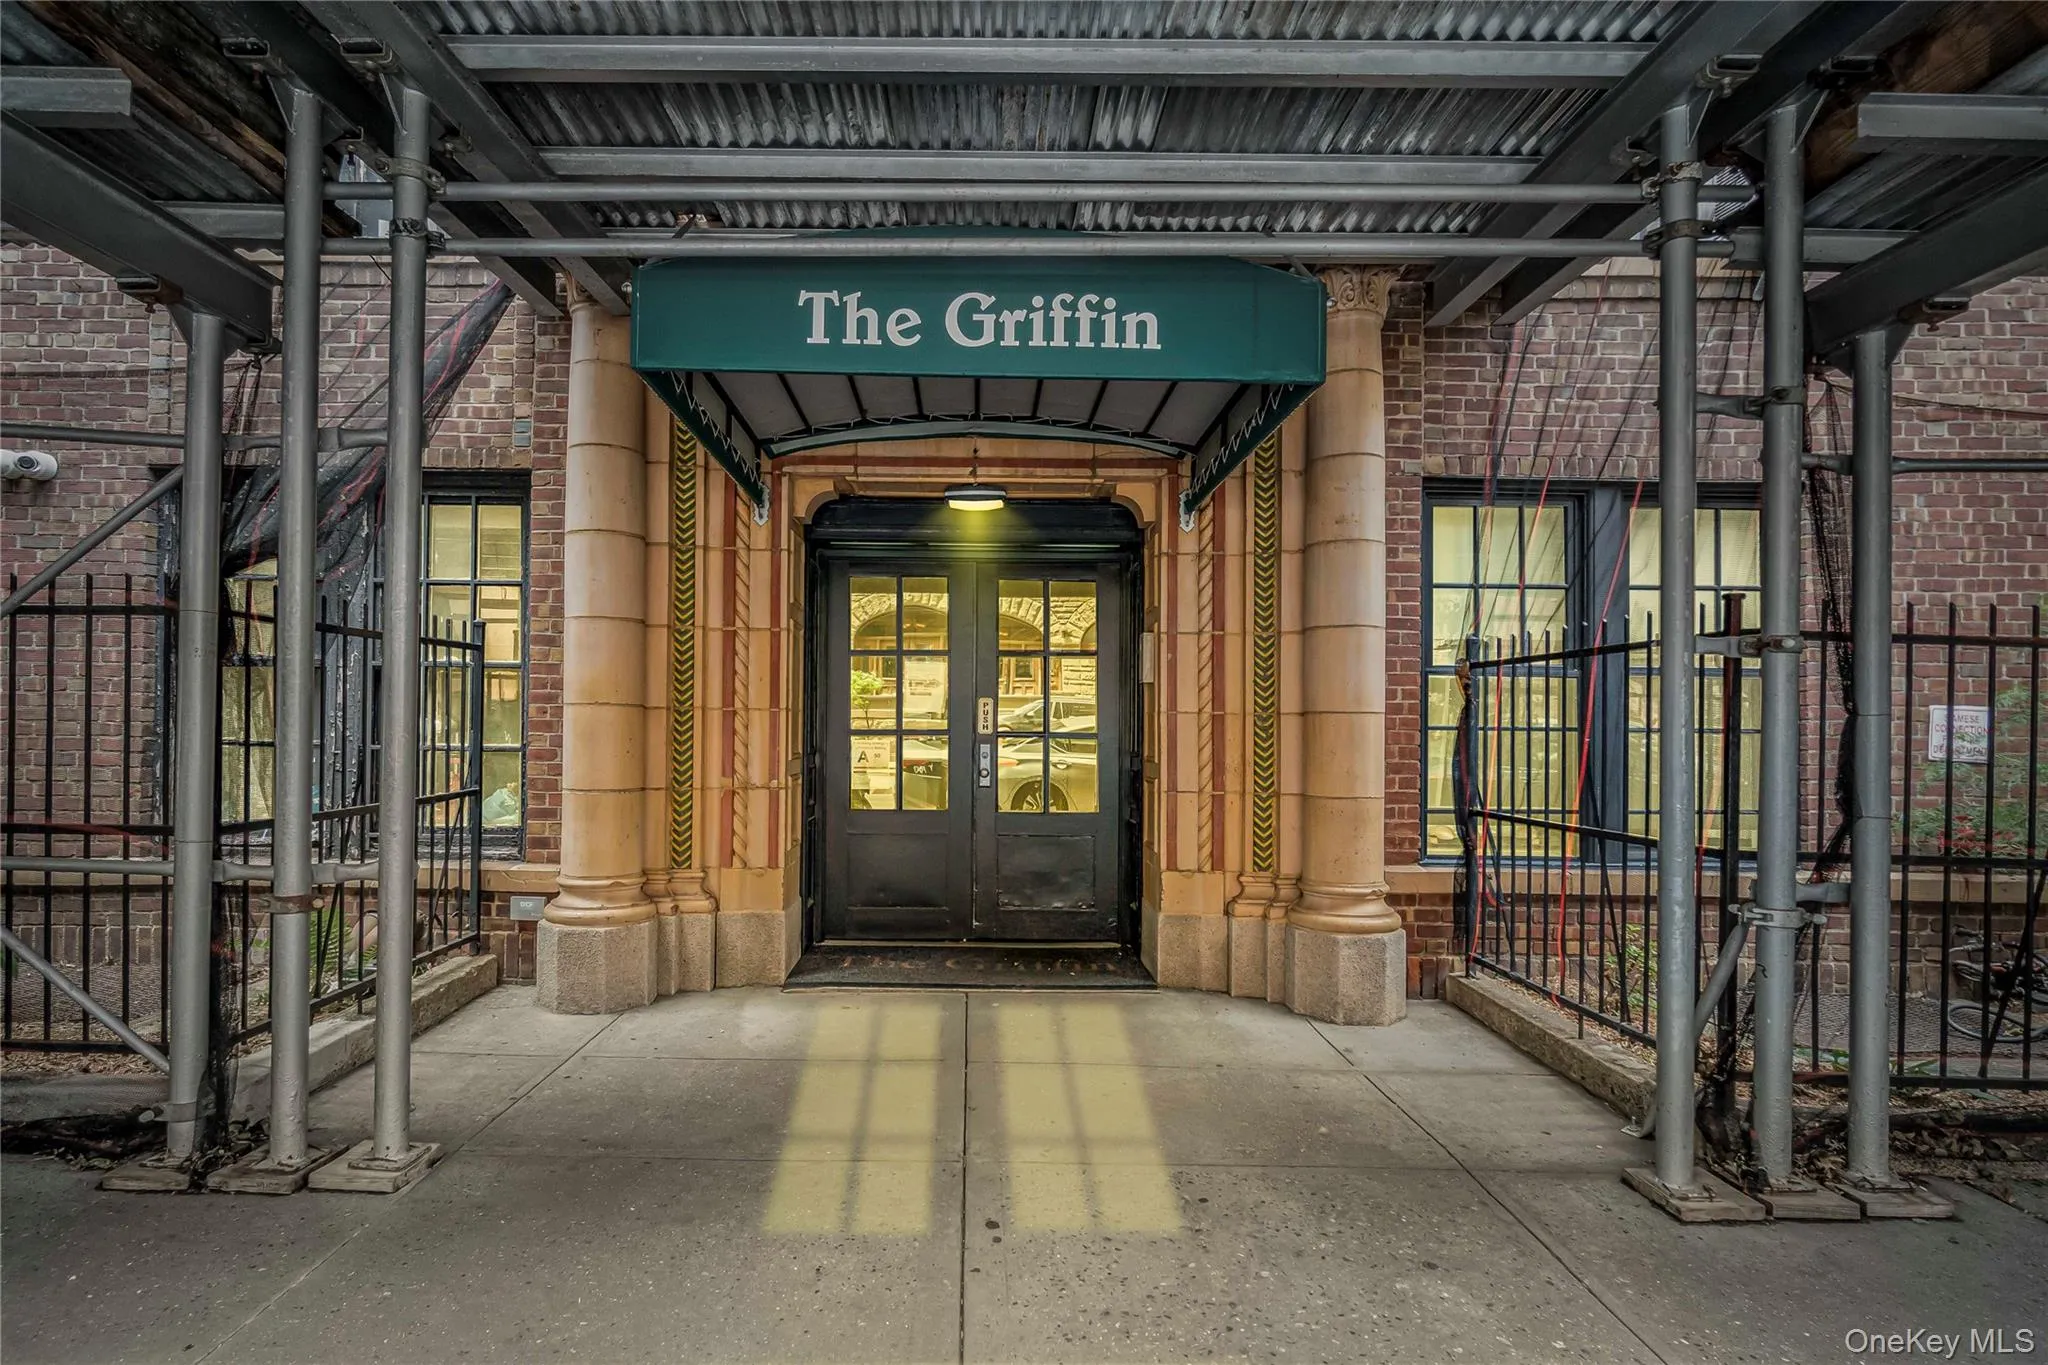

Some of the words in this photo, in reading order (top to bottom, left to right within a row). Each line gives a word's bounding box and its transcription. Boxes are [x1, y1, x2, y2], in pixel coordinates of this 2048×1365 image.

[798, 289, 922, 347] The
[944, 291, 1162, 350] Griffin
[1945, 713, 1980, 723] AMESE
